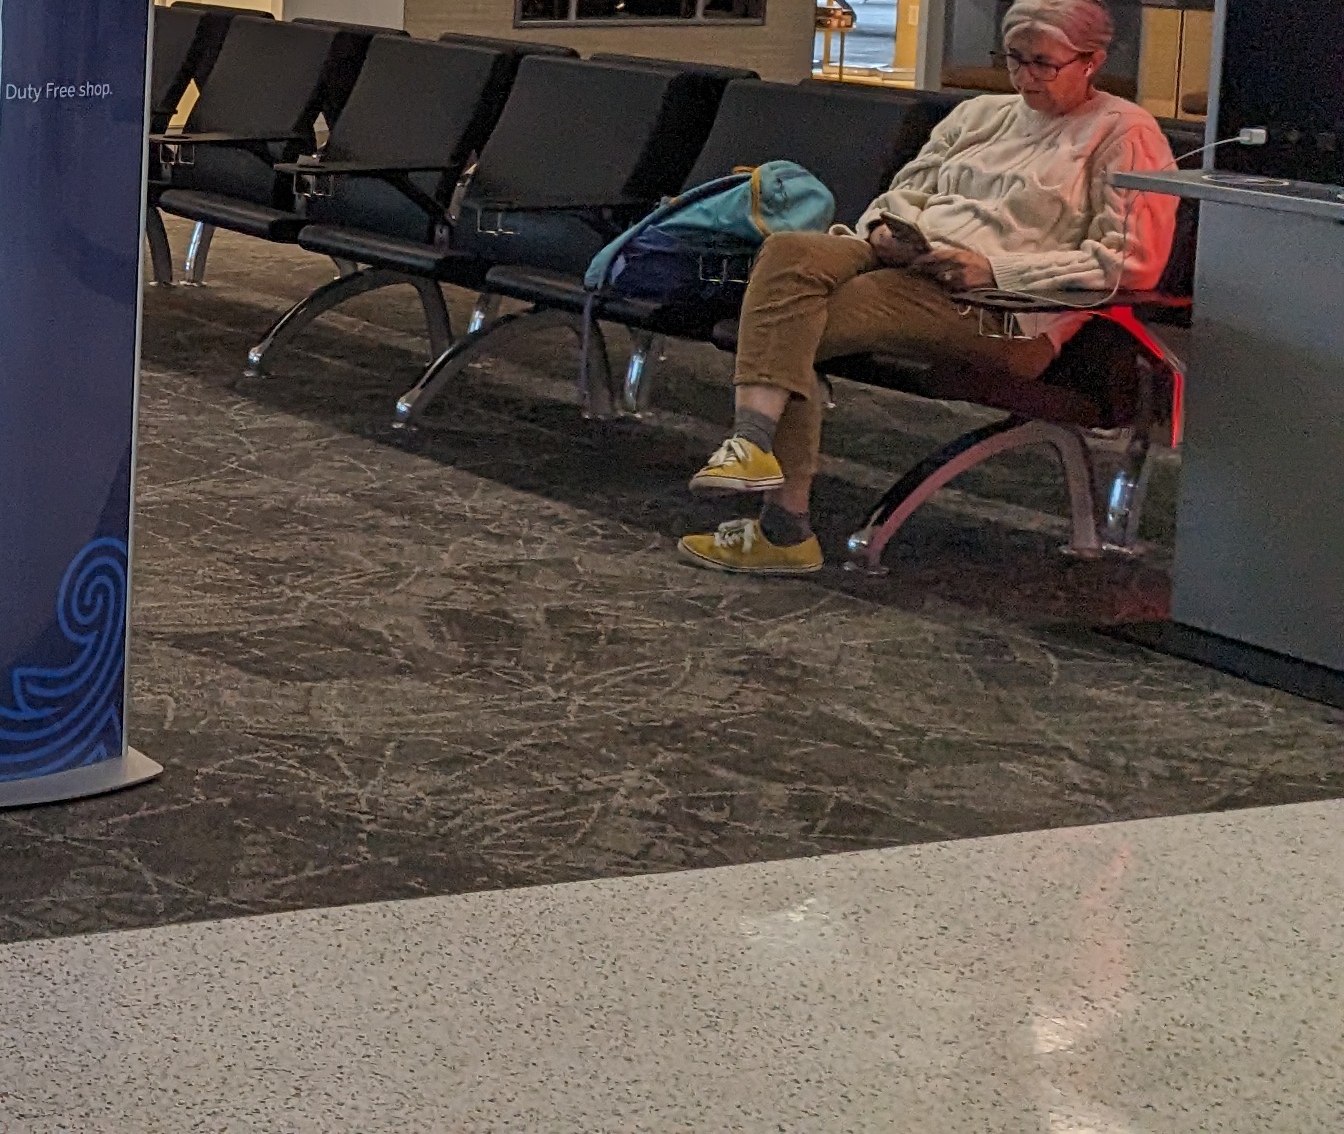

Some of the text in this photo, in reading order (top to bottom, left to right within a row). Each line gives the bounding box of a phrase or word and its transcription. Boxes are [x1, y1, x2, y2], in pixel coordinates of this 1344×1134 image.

[5, 82, 42, 103] Duty
[46, 82, 76, 99] Free
[78, 81, 114, 102] shop.
